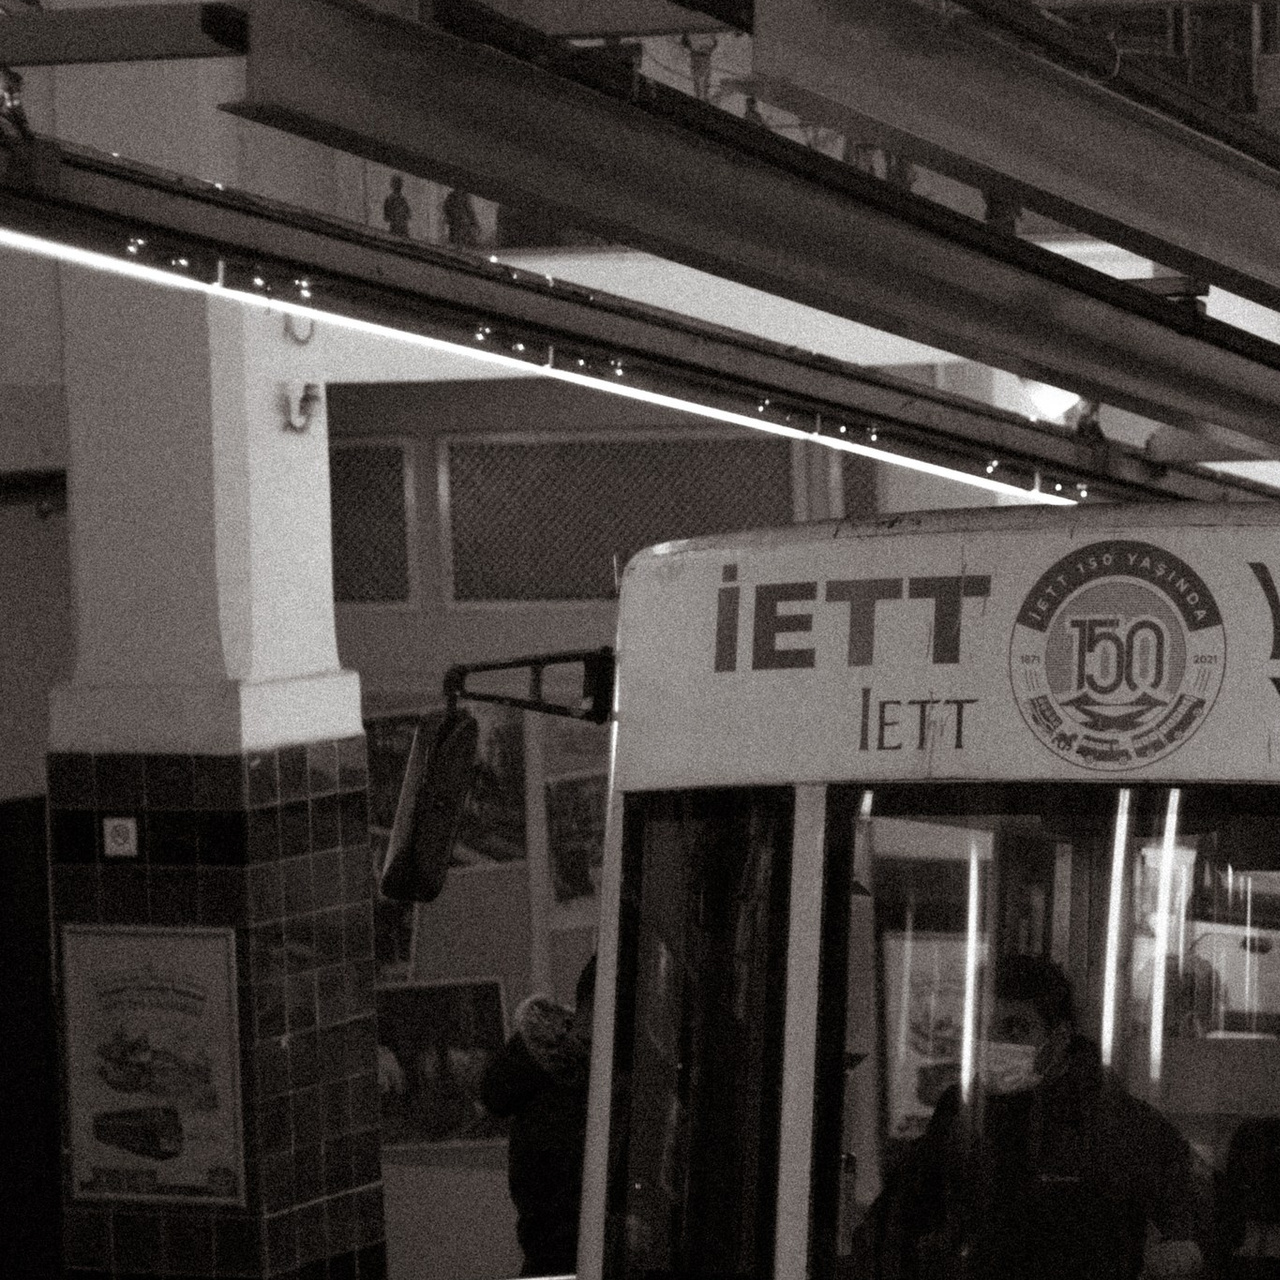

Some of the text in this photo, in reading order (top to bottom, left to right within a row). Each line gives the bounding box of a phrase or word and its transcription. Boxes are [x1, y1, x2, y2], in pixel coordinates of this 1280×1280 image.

[1070, 619, 1165, 695] 150
[1193, 655, 1218, 664] 2021
[858, 687, 979, 752] IETT
